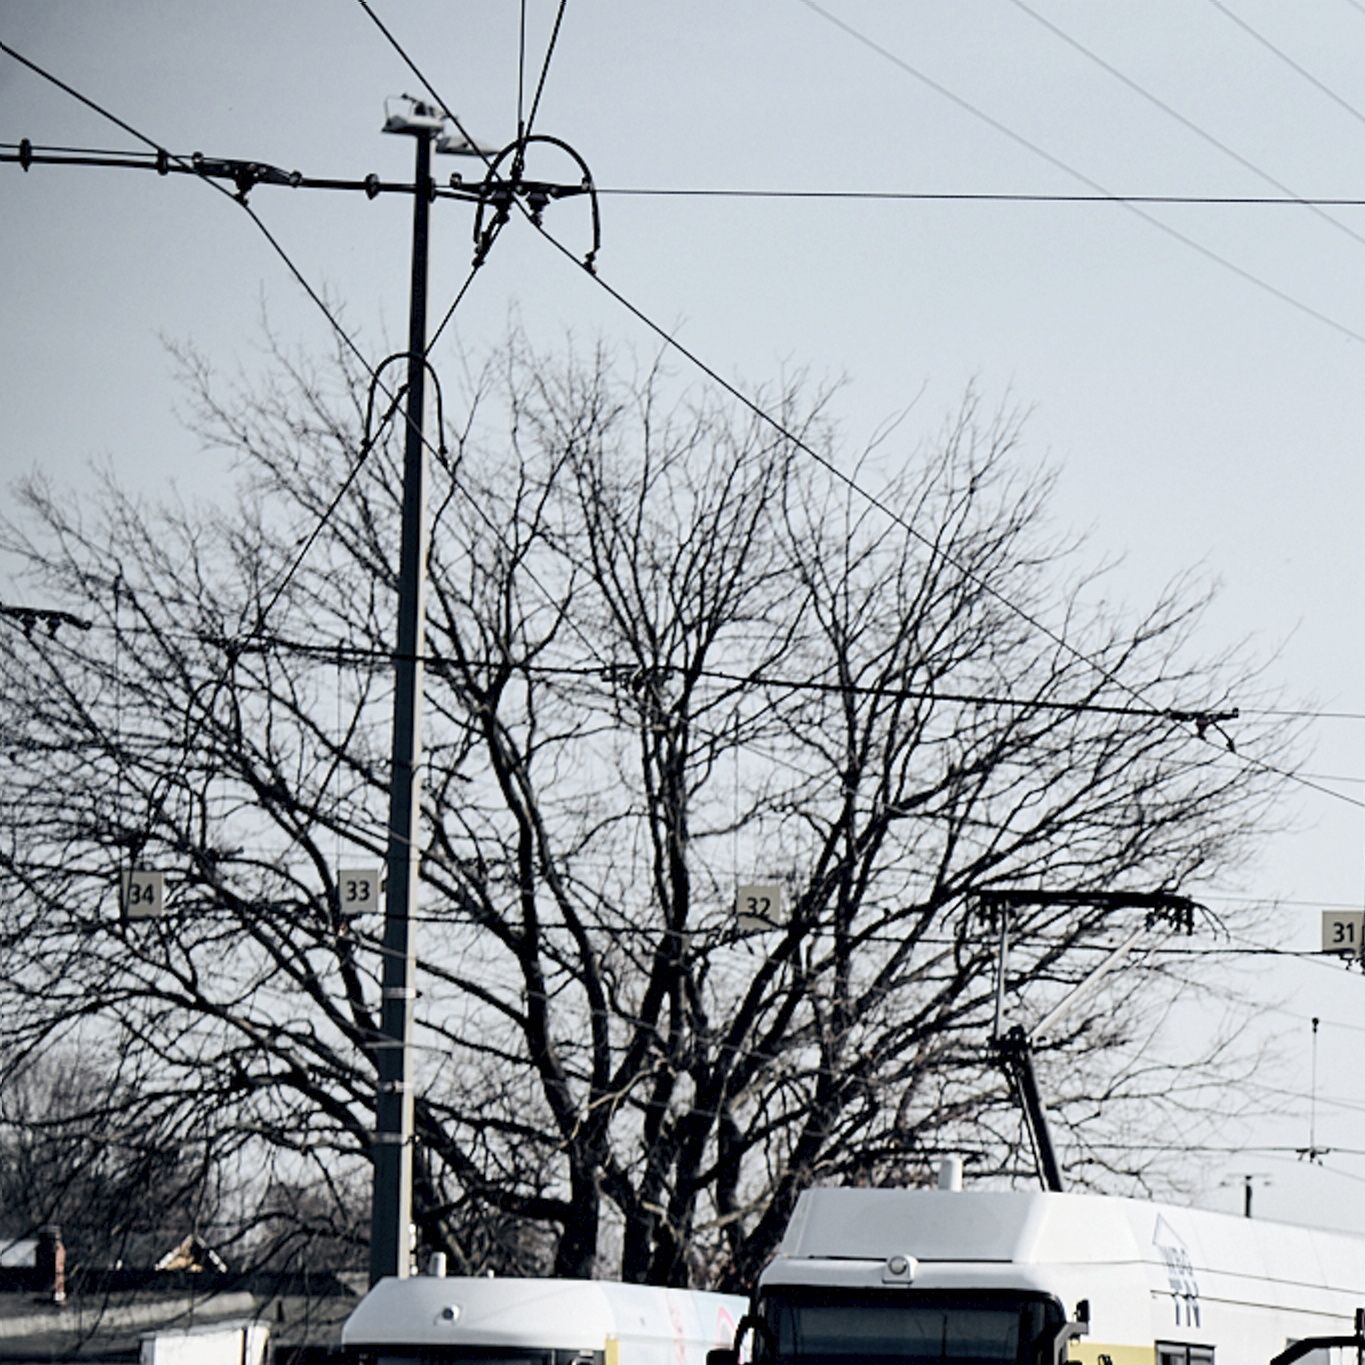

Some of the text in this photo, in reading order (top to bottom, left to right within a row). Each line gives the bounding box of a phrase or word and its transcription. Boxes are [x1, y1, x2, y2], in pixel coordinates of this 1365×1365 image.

[129, 884, 154, 904] 34
[346, 880, 370, 902] 33
[747, 897, 770, 919] 32
[1333, 922, 1355, 943] 31
